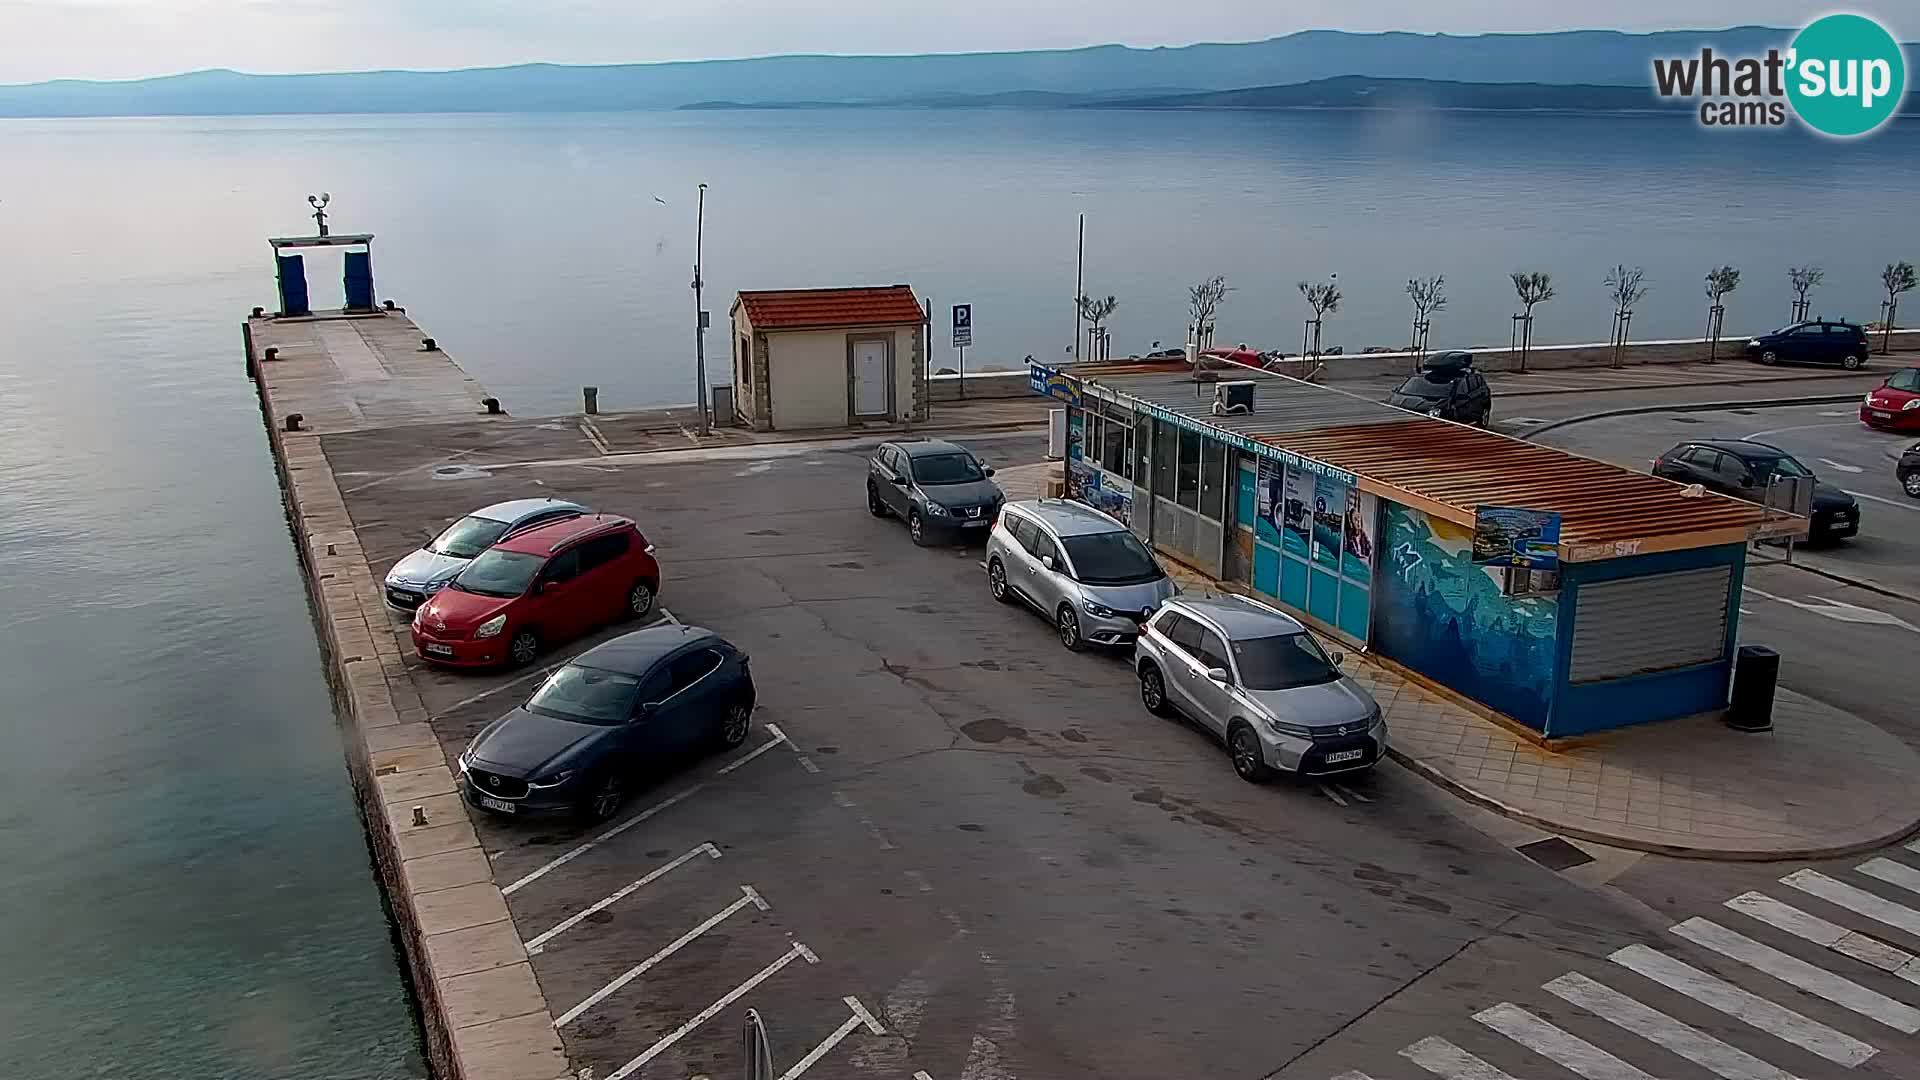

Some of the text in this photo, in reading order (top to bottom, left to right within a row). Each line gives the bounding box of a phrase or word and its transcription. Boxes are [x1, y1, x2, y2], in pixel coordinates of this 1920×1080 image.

[957, 308, 968, 325] P
[1178, 417, 1215, 437] AUTOBUSNA
[1215, 430, 1244, 448] POSTAJA
[1253, 443, 1268, 456] BUS
[1269, 447, 1299, 466] STATION
[1301, 456, 1326, 475] TICKET
[1327, 468, 1353, 484] OFFICE
